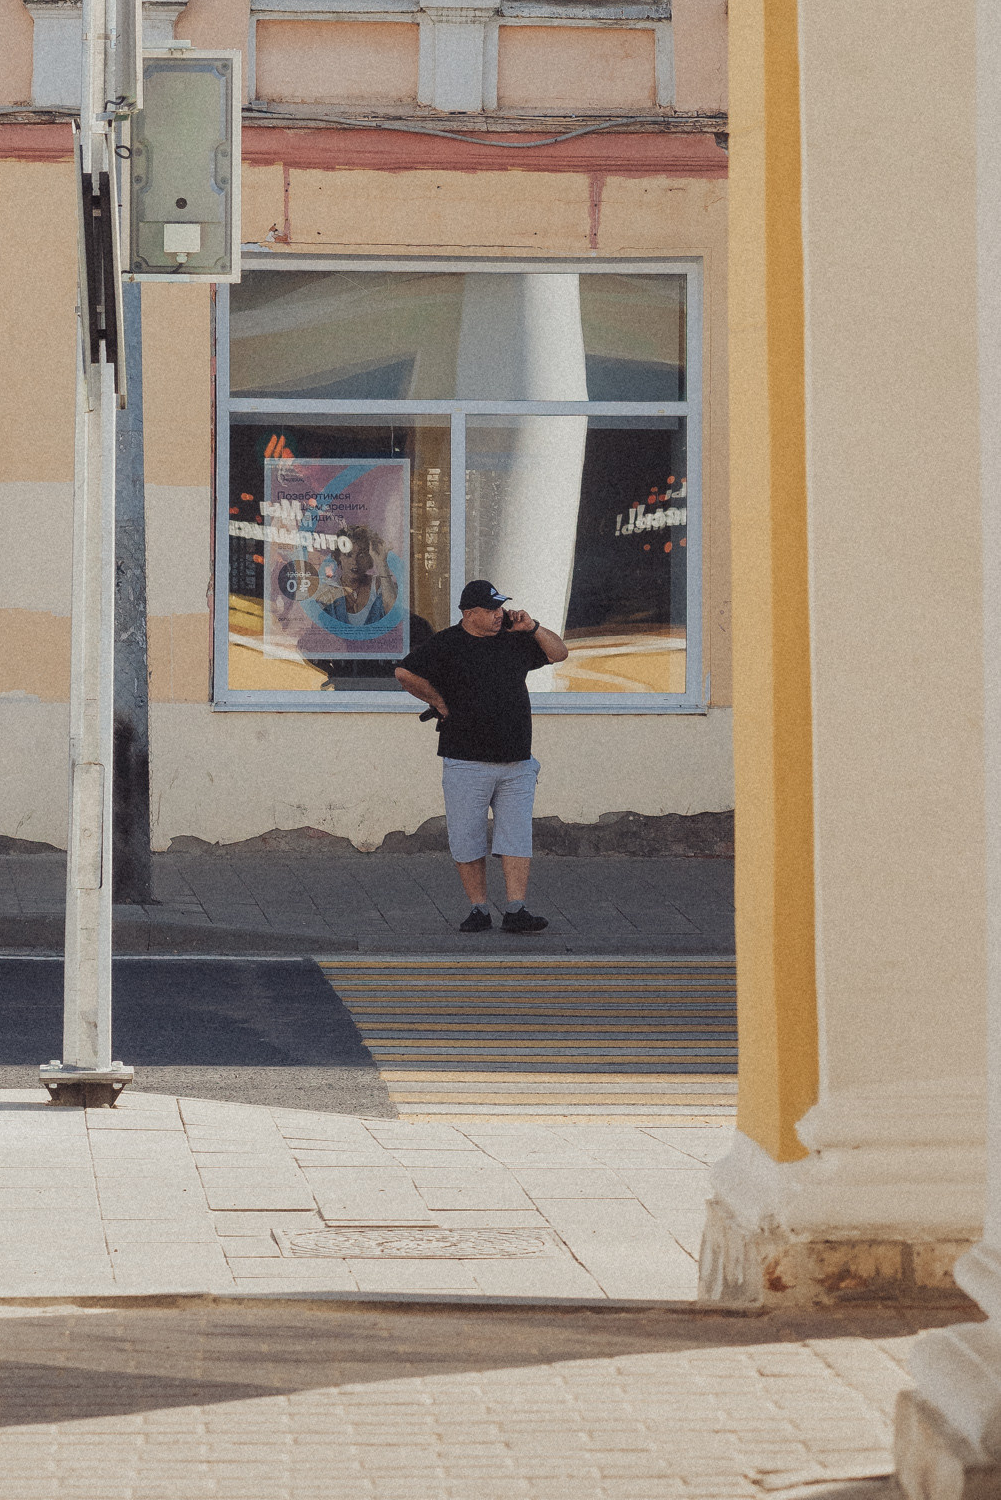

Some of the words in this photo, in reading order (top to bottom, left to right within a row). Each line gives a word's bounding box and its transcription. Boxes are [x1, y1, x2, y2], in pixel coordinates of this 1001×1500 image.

[277, 490, 351, 501] Позаботимся
[325, 503, 368, 514] зрении.
[286, 579, 298, 593] 0
